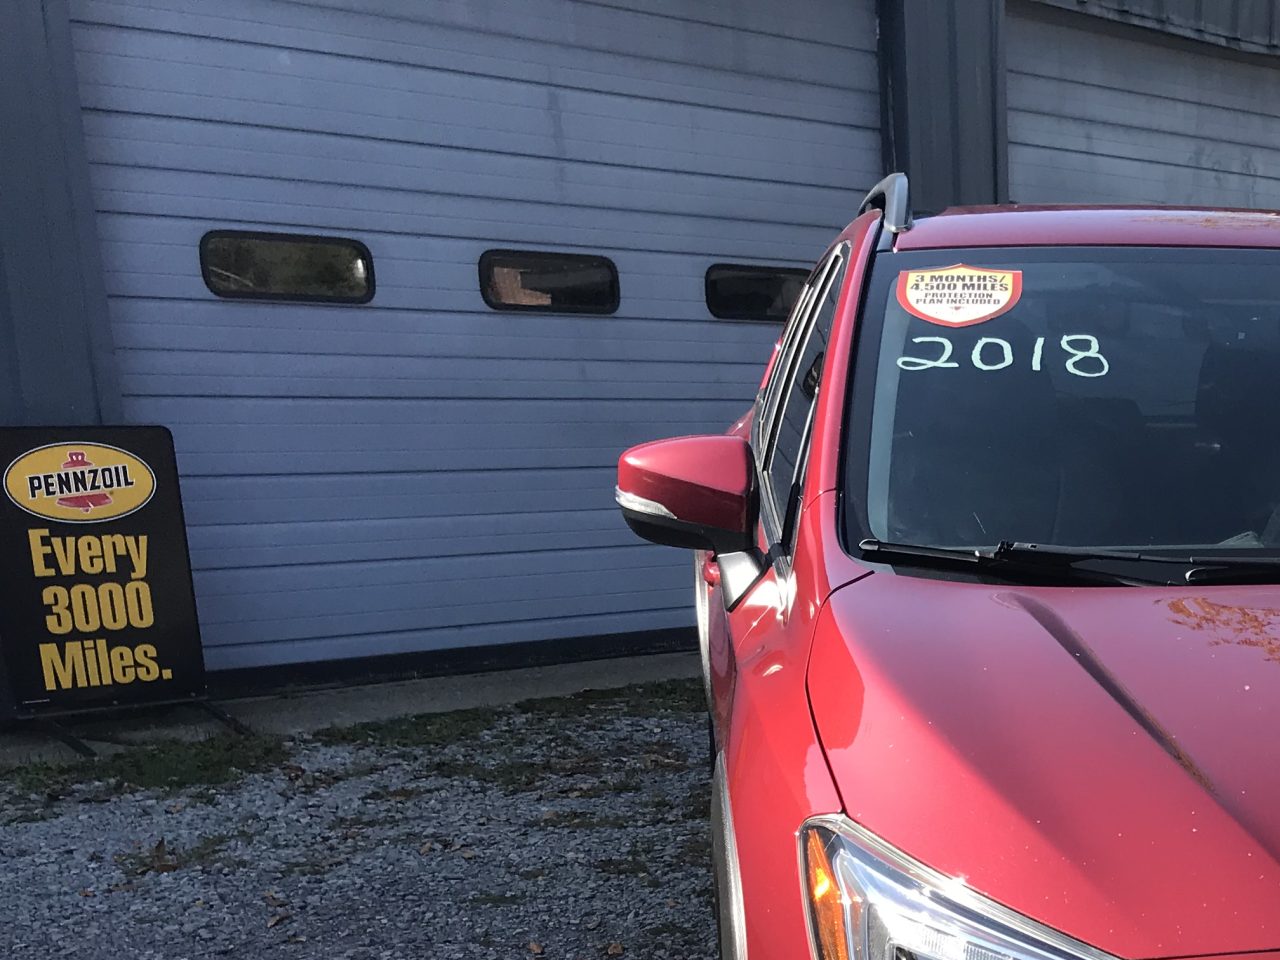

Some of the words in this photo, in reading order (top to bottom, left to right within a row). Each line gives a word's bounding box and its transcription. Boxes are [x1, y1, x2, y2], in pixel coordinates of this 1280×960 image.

[914, 275, 925, 283] 3
[961, 283, 1009, 291] MILES
[896, 334, 1109, 377] 2018
[27, 464, 136, 500] PENNZOIL
[28, 528, 148, 580] Every
[42, 580, 155, 635] 3000
[39, 638, 173, 691] Miles.
